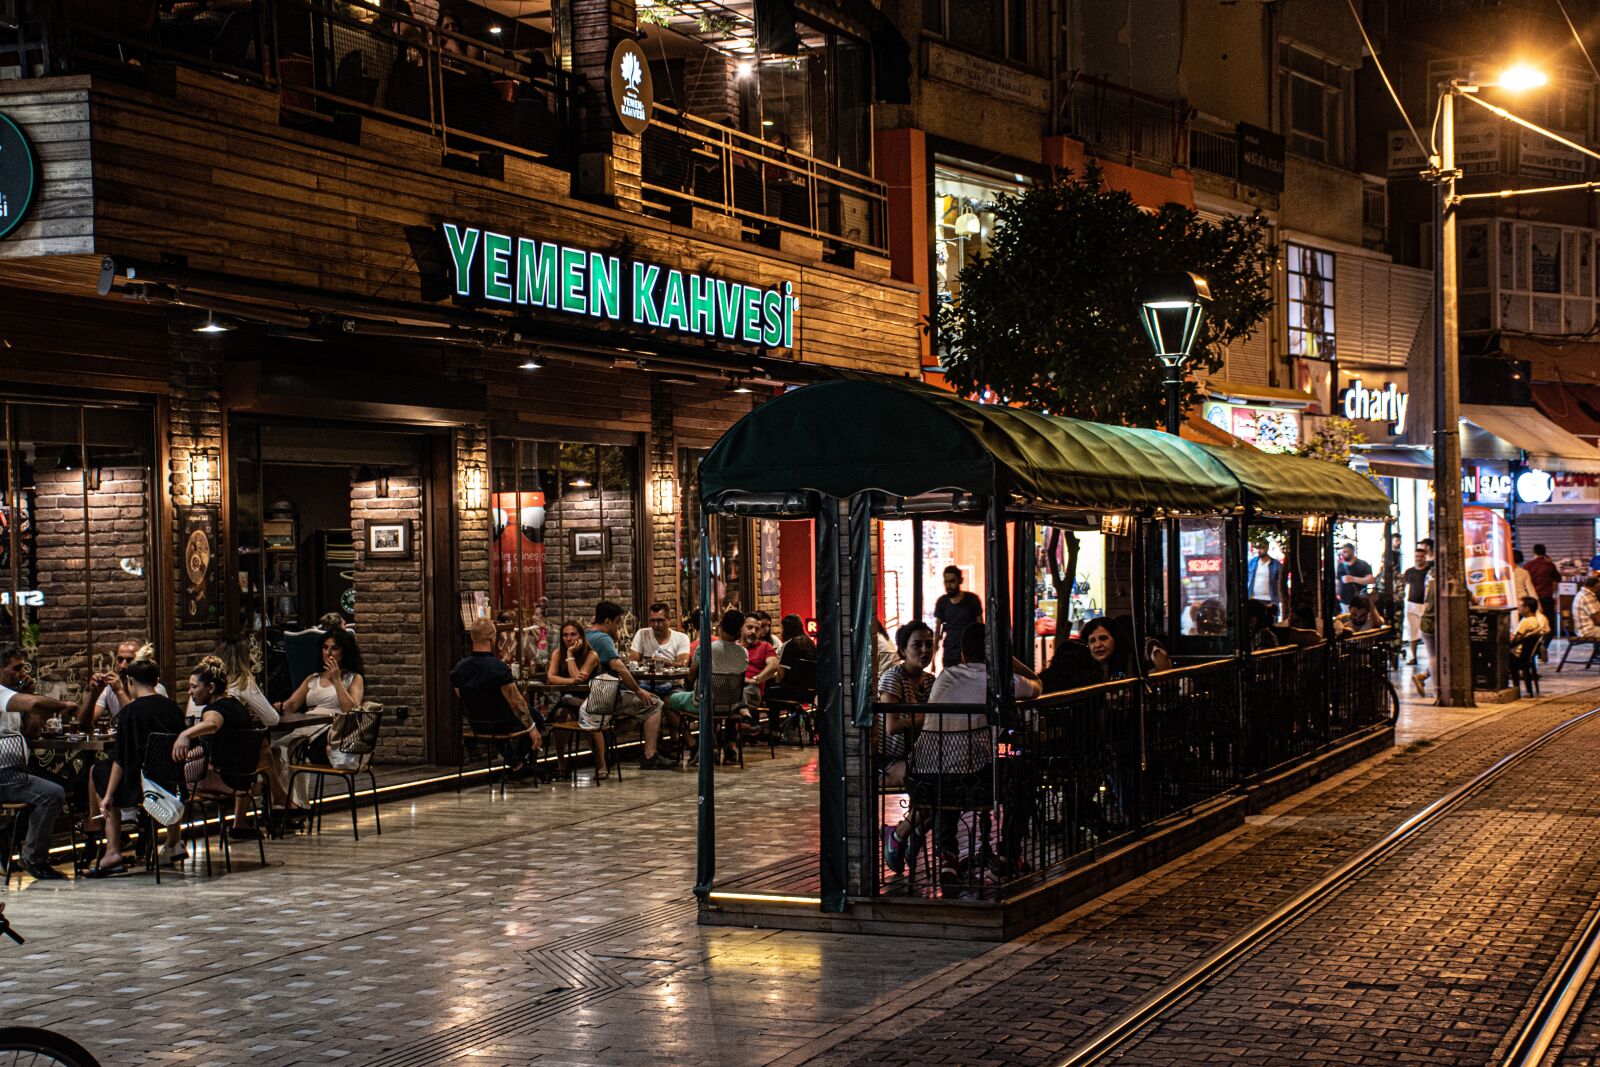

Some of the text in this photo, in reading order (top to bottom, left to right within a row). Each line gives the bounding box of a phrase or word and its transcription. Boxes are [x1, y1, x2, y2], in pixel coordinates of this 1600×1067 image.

[621, 105, 645, 120] KAHVESİ
[622, 96, 644, 110] YEMEN
[442, 222, 620, 320] YEMEN
[1344, 380, 1409, 435] charly
